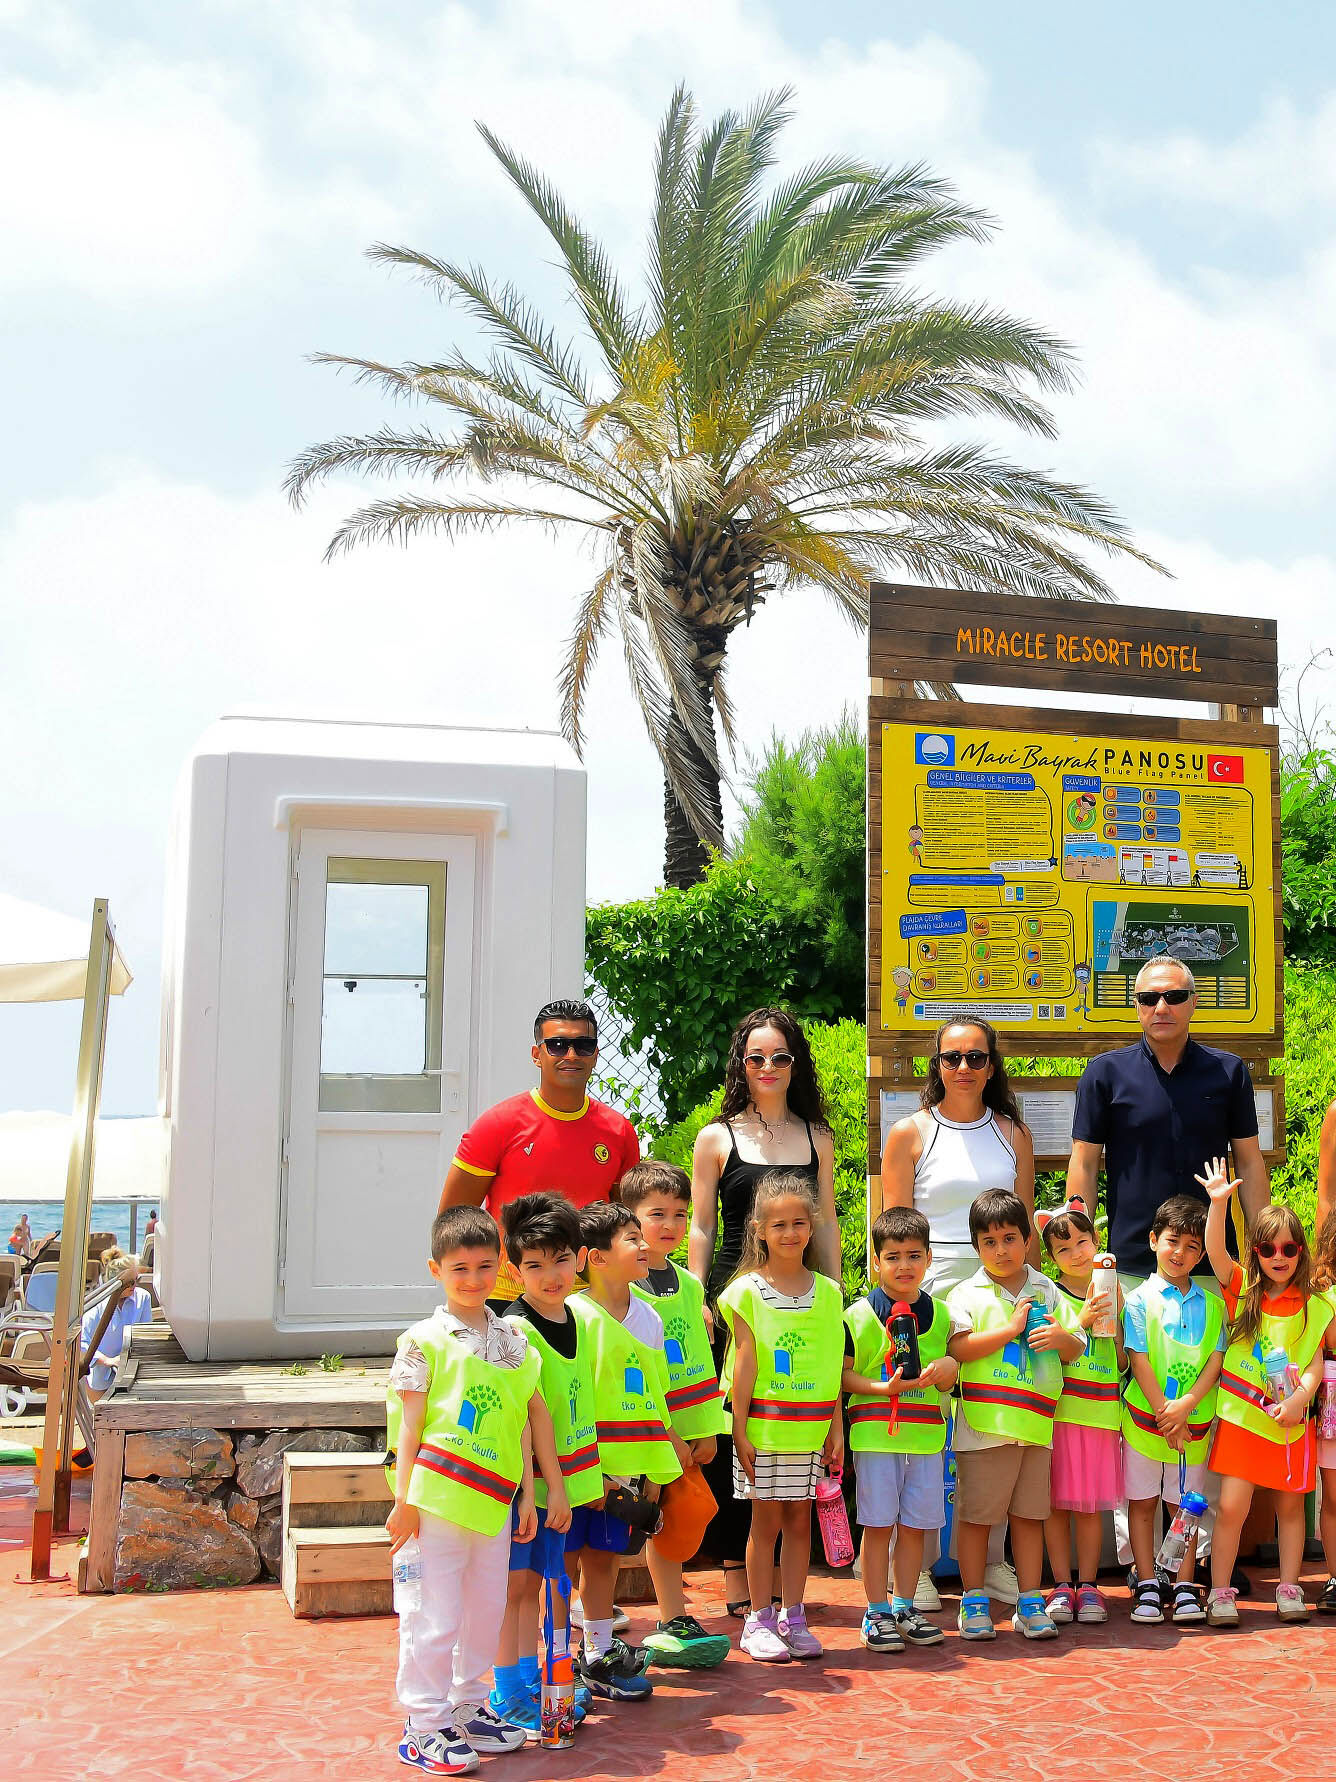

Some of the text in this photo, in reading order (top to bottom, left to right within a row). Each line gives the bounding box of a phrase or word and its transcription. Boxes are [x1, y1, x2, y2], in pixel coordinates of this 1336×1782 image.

[956, 627, 1202, 673] MIRACLE RESORT HOTEL
[960, 741, 1203, 778] Mavi Bayrak PANOSU
[930, 771, 954, 781] GENEL
[1104, 767, 1204, 780] Blue Flag Panel
[1239, 1359, 1254, 1372] Eko
[993, 1368, 1009, 1379] Eko
[770, 1380, 785, 1390] Eko
[621, 1400, 636, 1411] Eko
